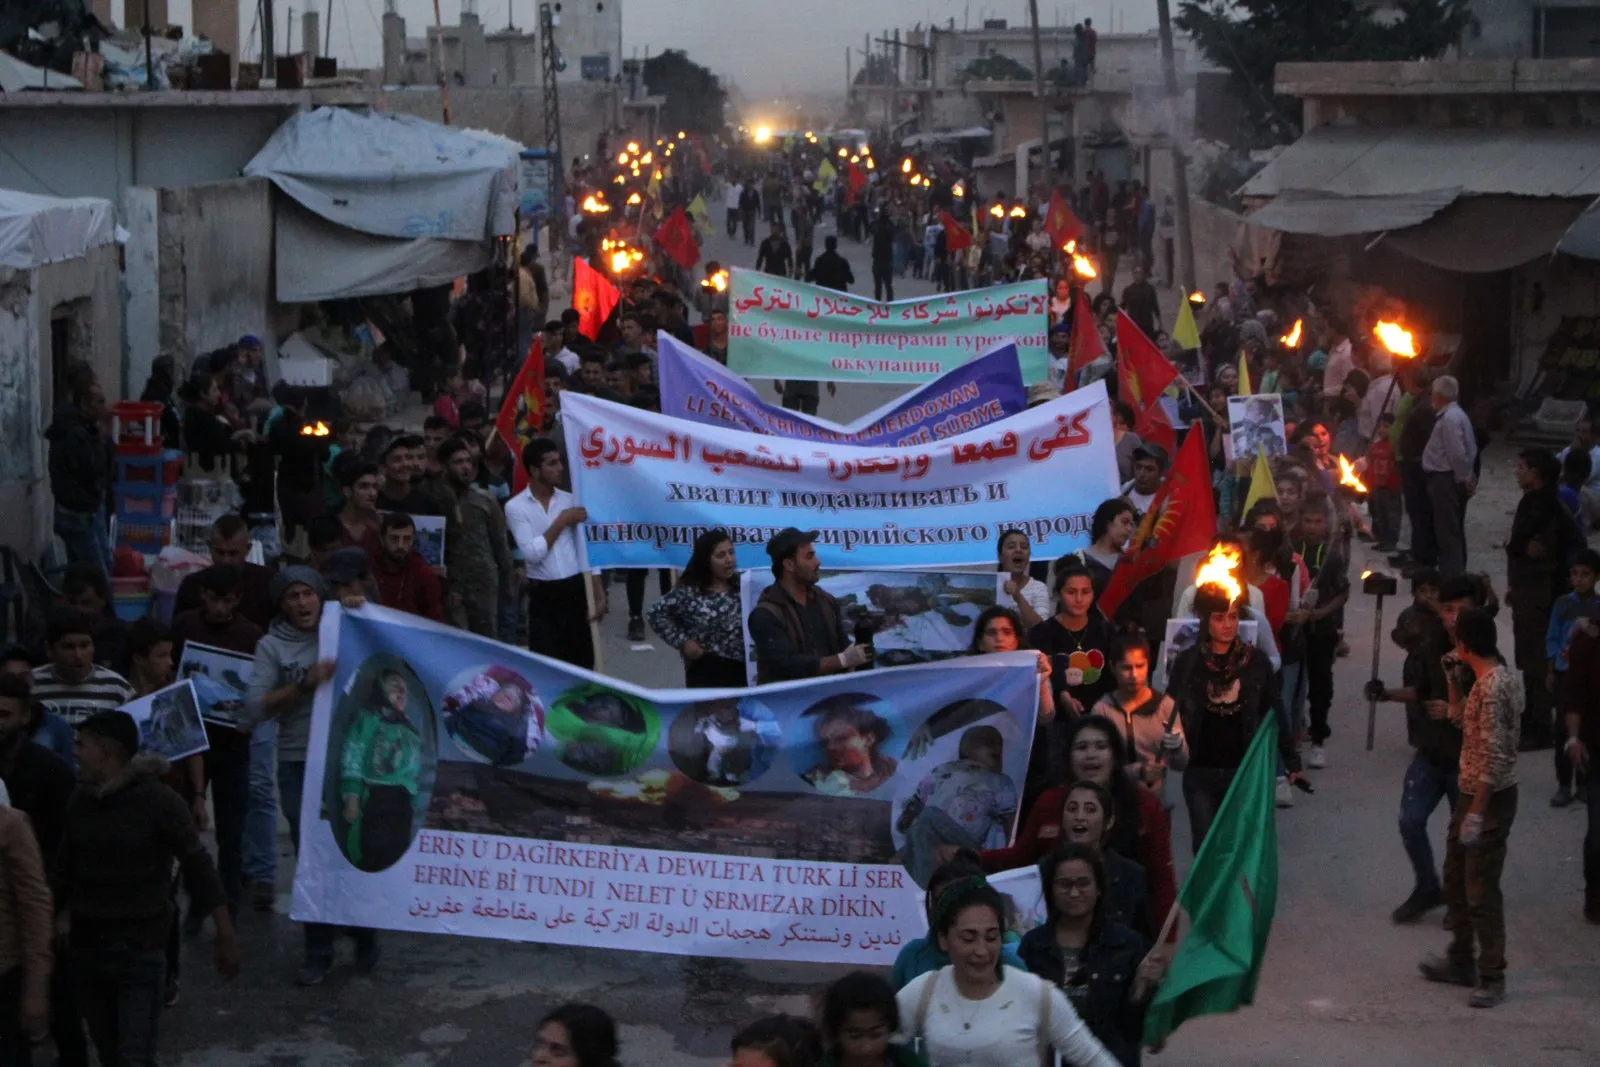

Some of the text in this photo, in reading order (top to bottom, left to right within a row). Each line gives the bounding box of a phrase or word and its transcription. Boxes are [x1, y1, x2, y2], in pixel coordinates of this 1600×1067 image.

[735, 286, 800, 314] التركي
[900, 296, 959, 324] شركاء
[730, 321, 1047, 352] не будьте партнерами турекой
[830, 356, 942, 375] оккупации
[885, 381, 981, 434] ERDOXAN
[579, 425, 692, 468] السوري
[700, 445, 802, 475] للشعب
[779, 482, 979, 514] подавливать
[985, 481, 1008, 501] и
[994, 513, 1096, 545] народ
[657, 855, 765, 883] DEWLETA
[864, 870, 905, 889] SER
[496, 867, 518, 892] Bİ
[606, 880, 675, 906] NELET
[703, 889, 816, 916] ŞERMEZAR
[408, 895, 902, 951] ندين ونستنكر هجمات الدولة التركية على مقاطعة عفرين
